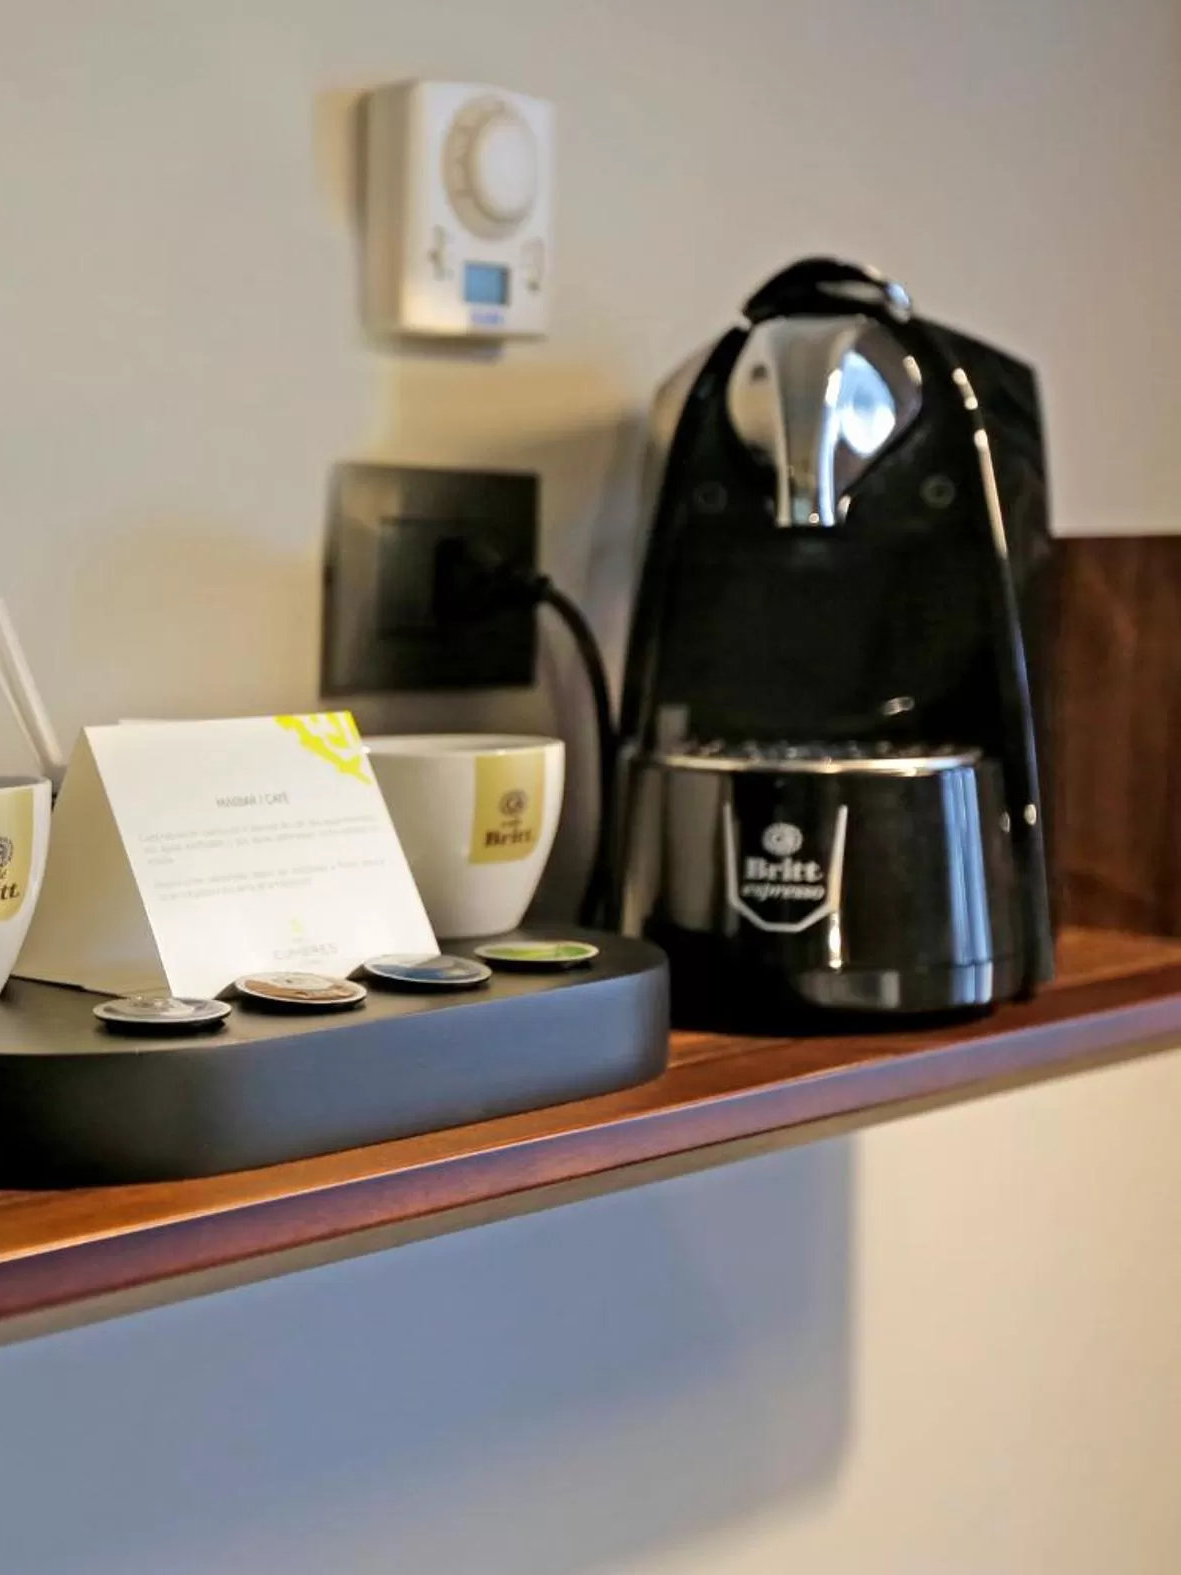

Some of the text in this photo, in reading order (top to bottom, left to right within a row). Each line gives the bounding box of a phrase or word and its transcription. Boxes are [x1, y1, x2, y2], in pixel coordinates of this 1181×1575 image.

[484, 827, 532, 849] Britt
[745, 855, 824, 882] Britt
[741, 883, 825, 902] espresso
